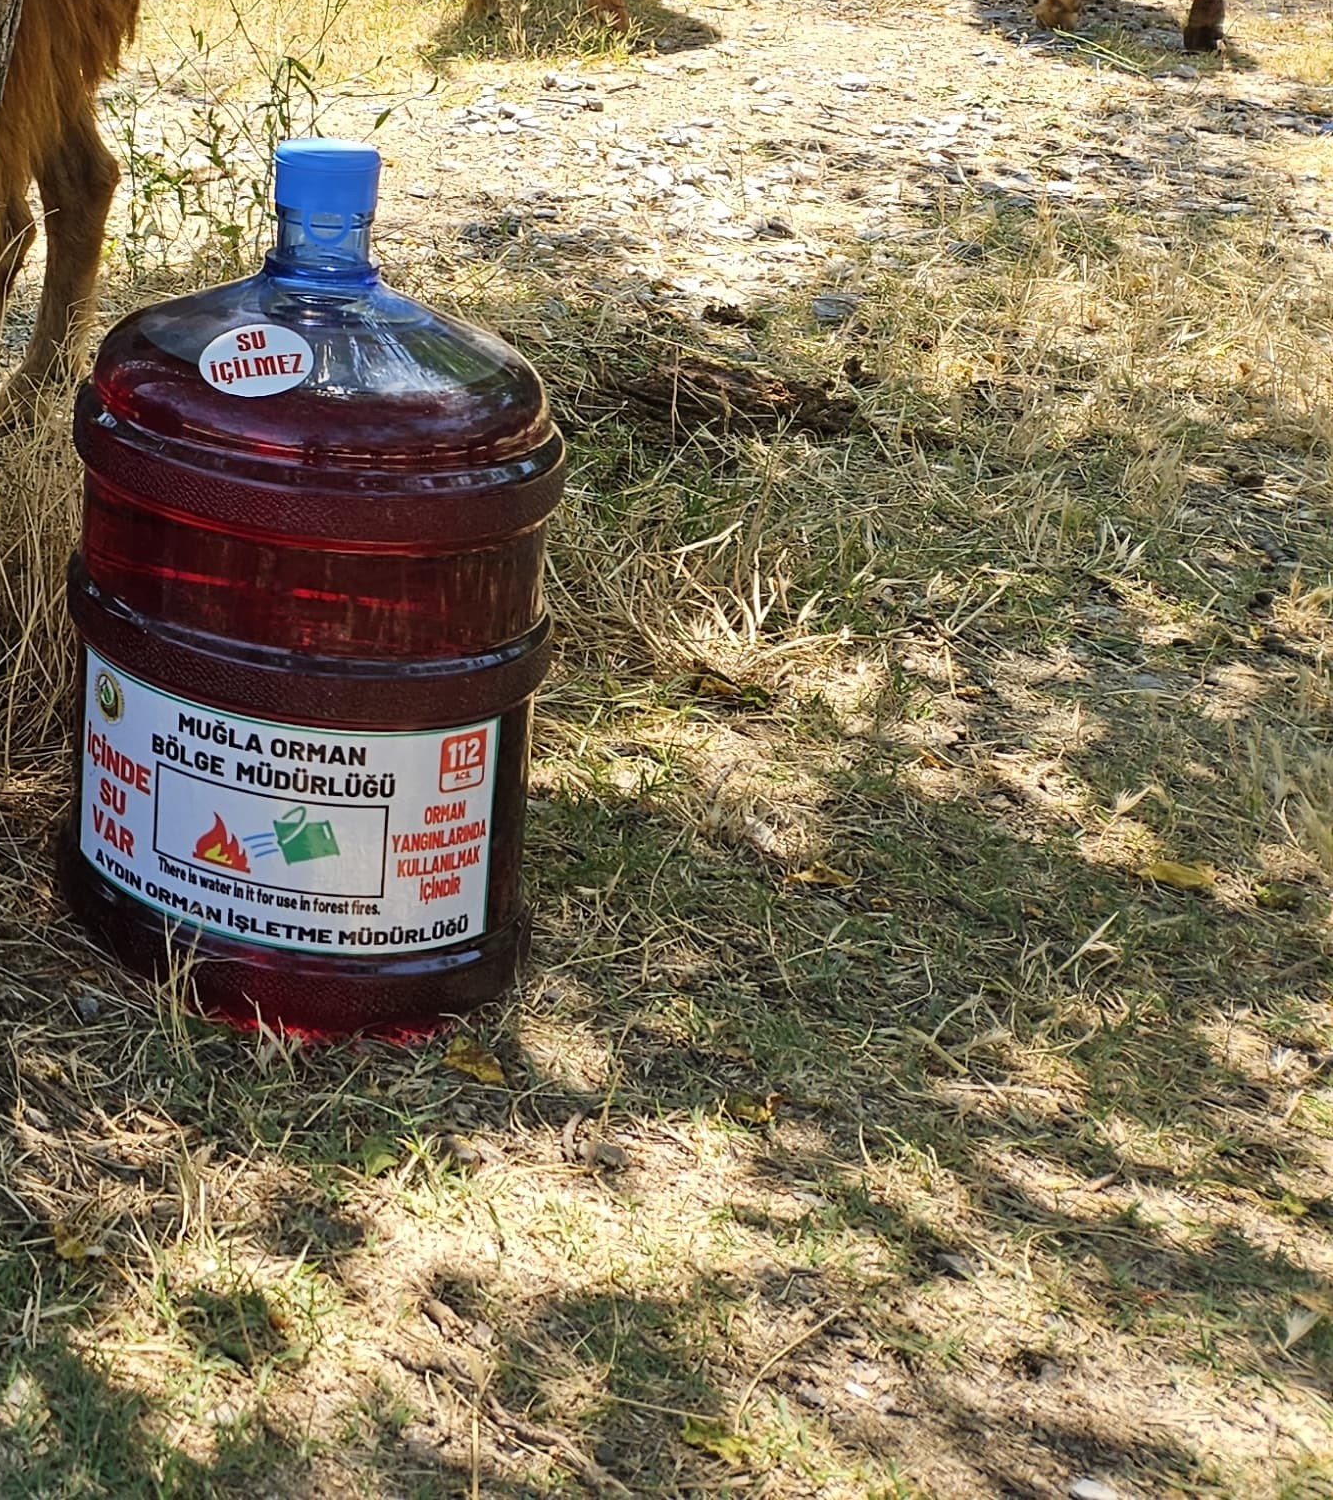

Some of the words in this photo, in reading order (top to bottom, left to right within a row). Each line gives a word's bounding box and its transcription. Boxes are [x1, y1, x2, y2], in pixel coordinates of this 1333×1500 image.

[236, 330, 266, 352] SU
[209, 353, 305, 384] İÇİLMEZ
[178, 712, 263, 755] MUĞLA
[270, 738, 367, 766] ORMAN
[448, 738, 480, 769] 112
[88, 720, 152, 796] İÇİNDE
[151, 733, 225, 777] BÖLGE
[236, 761, 396, 799] MÜDÜRLÜĞÜ
[100, 778, 126, 816] SU
[424, 799, 466, 825] ORMAN
[93, 804, 135, 859] VAR
[392, 818, 486, 853] YANGINLARINDA
[397, 845, 481, 878] KULLANILMAK
[95, 848, 142, 891] AYDIN
[145, 881, 222, 924] ORMAN
[228, 908, 332, 944] İŞLETME
[338, 914, 469, 946] MÜDÜRLÜĞÜ
[158, 855, 186, 881] There
[188, 868, 197, 885] is
[199, 875, 232, 896] water
[234, 882, 244, 900] in
[245, 885, 254, 902] it
[256, 888, 274, 906] for
[276, 895, 298, 910] use
[300, 895, 311, 912] in
[312, 897, 349, 915] forest
[351, 899, 381, 916] fires.
[419, 872, 461, 905] İÇİNDİR
